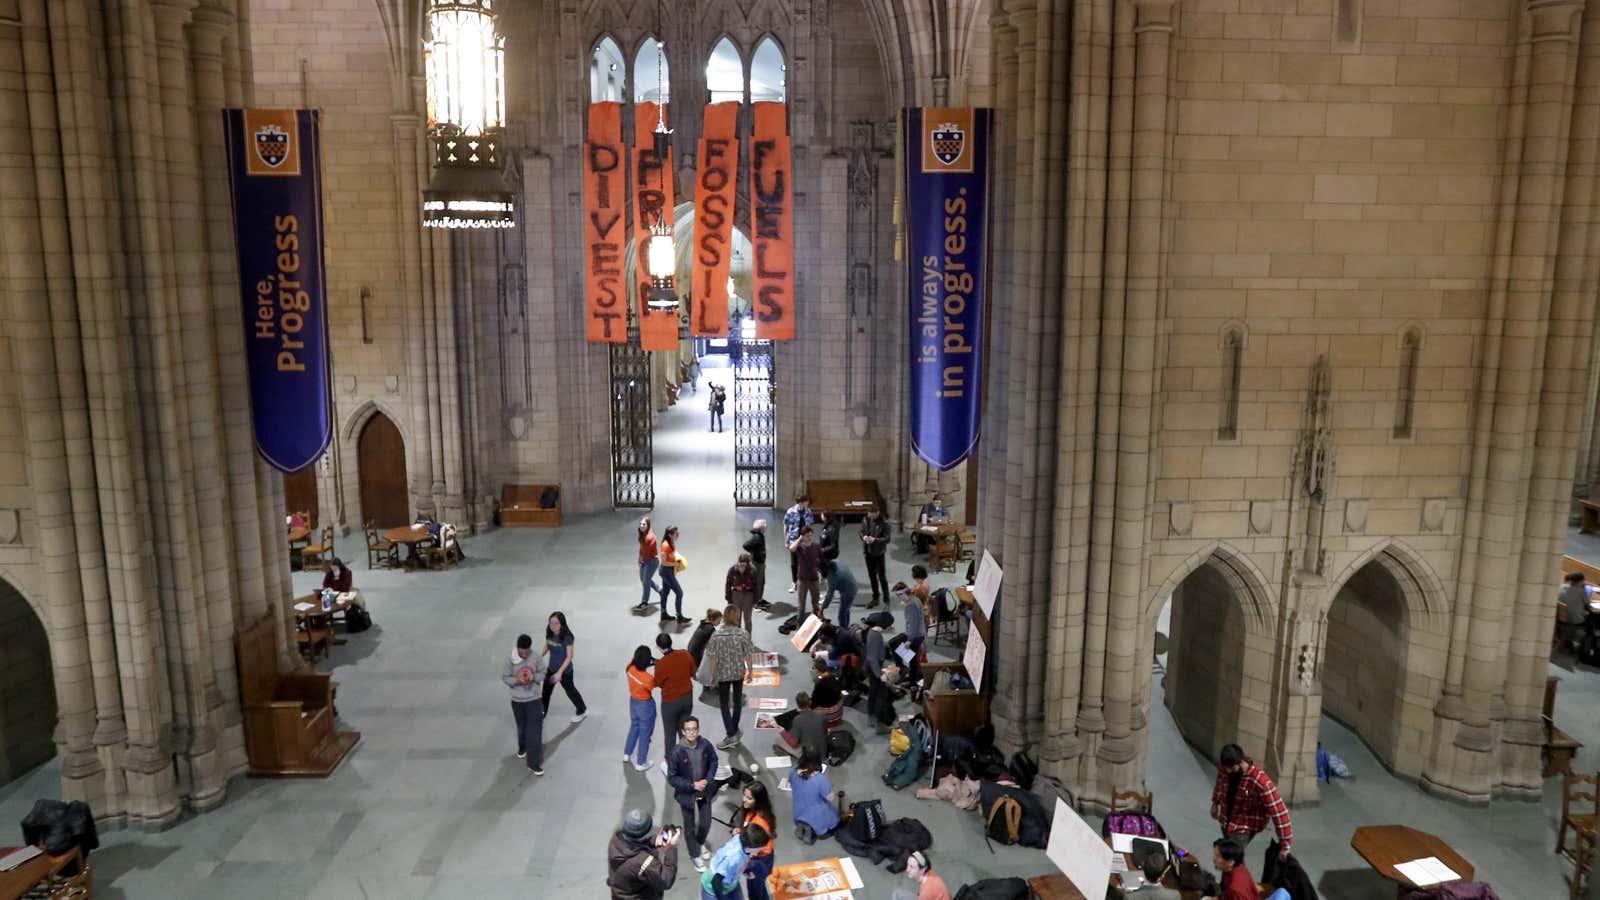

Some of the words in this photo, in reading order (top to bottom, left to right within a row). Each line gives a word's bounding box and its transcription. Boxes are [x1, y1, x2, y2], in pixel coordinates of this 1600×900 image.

[255, 274, 275, 338] Here,
[275, 214, 311, 372] Progress
[590, 144, 621, 338] DIVEST
[699, 139, 729, 334] FOSSIL
[754, 140, 786, 322] FUELS
[918, 255, 943, 337] always
[943, 187, 974, 354] progress.
[917, 344, 937, 363] is
[935, 366, 964, 398] in
